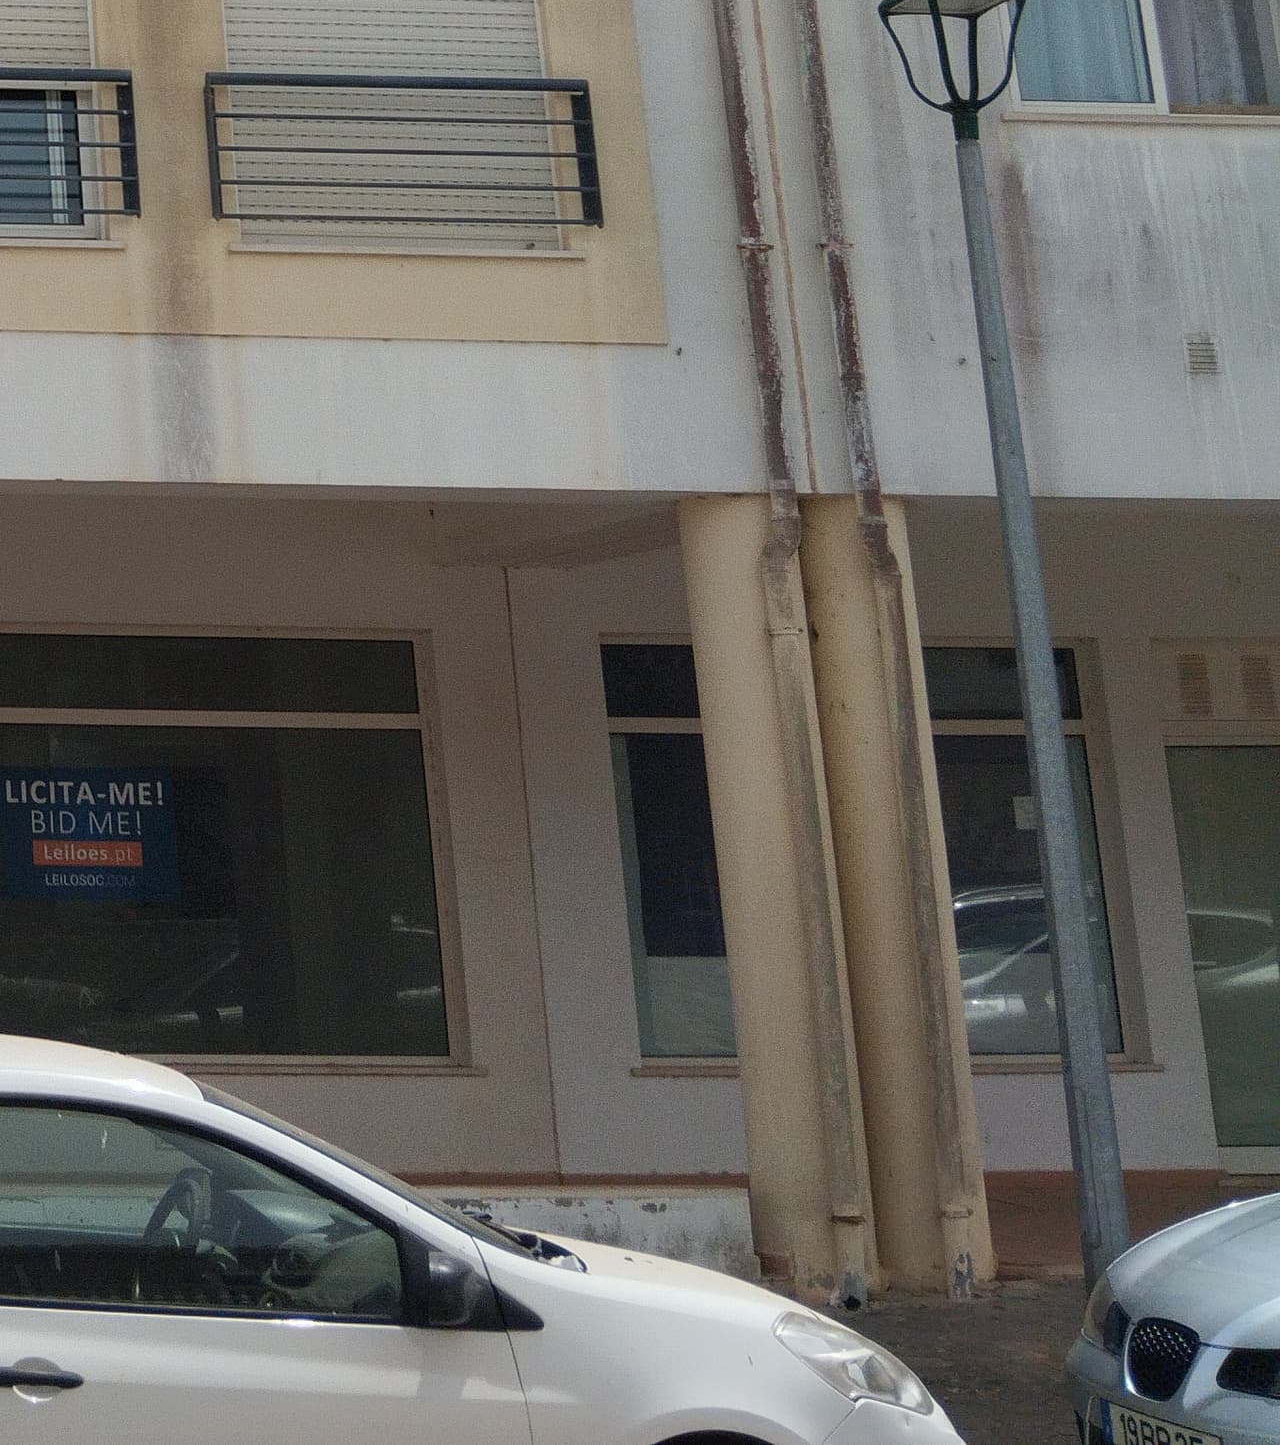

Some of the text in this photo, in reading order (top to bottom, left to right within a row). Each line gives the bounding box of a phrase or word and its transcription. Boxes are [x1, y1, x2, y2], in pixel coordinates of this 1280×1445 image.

[5, 779, 164, 806] LICITA-ME!
[31, 809, 142, 835] BID ME!
[43, 843, 133, 863] Leiloes.pt
